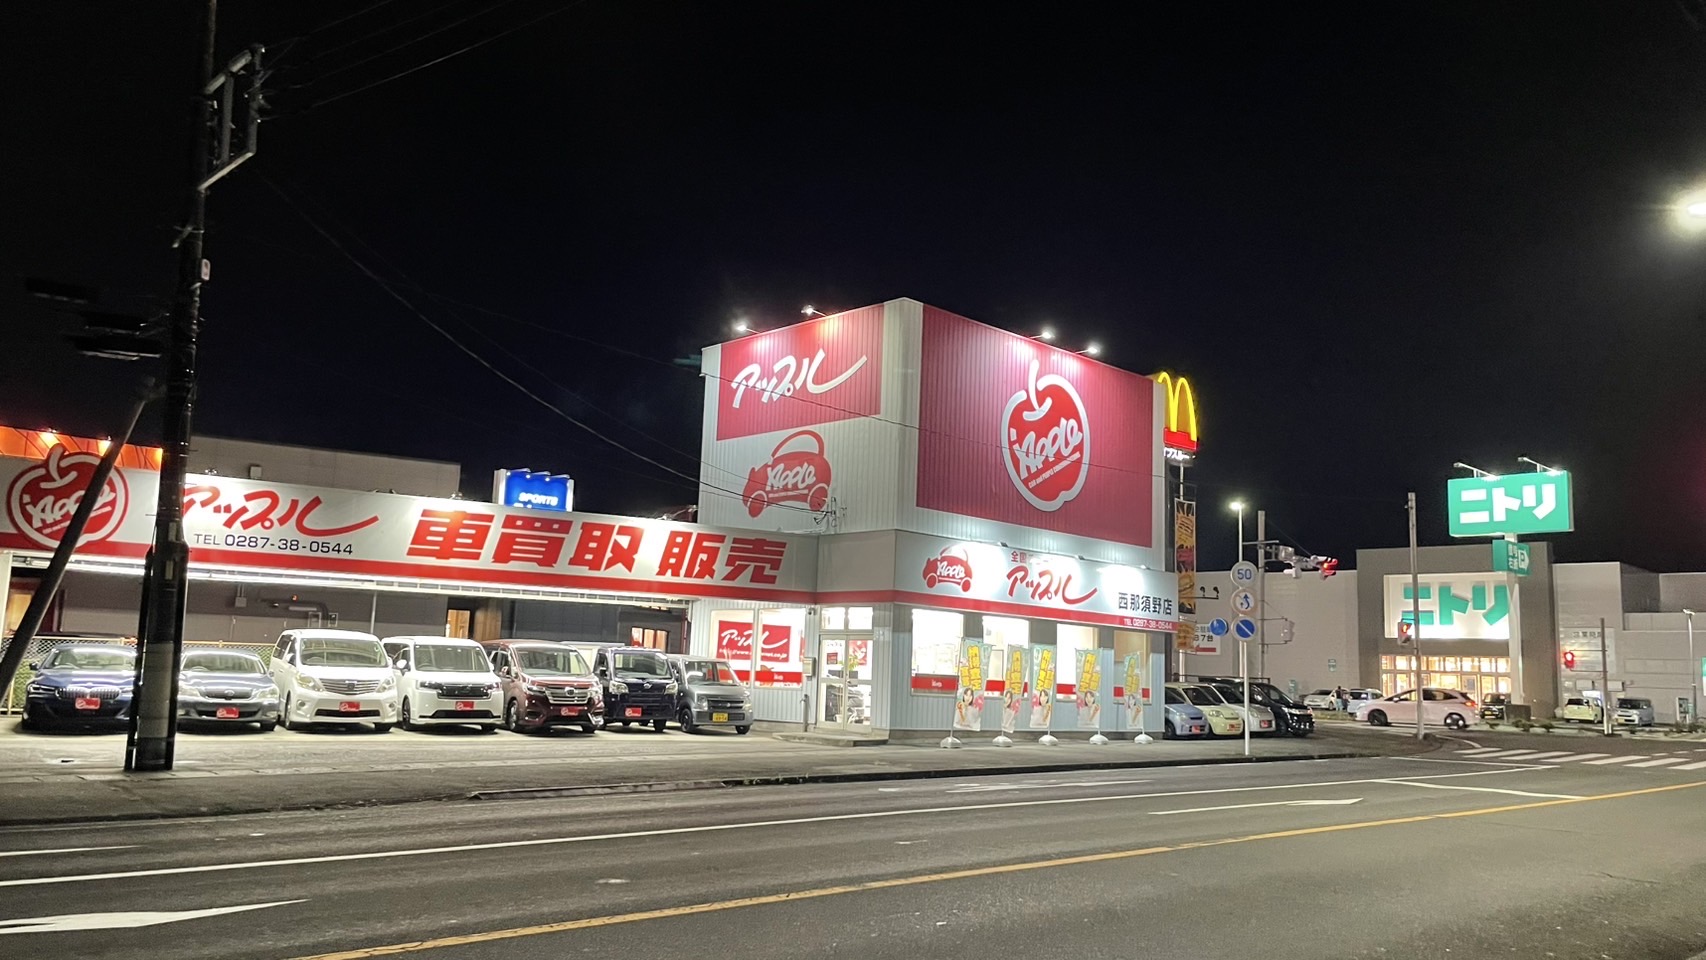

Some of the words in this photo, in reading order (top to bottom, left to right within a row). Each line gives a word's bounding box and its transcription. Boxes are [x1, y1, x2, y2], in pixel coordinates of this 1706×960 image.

[730, 347, 867, 409] アップル
[182, 484, 380, 538] アップル
[1459, 483, 1557, 524] ニトリ
[193, 533, 220, 546] TEL
[224, 534, 353, 555] 0287-38-0544
[406, 508, 645, 573] 車買取
[655, 530, 788, 585] 販売
[1006, 565, 1098, 605] アップル
[1237, 568, 1252, 580] 50
[1118, 591, 1173, 616] 西那須野店
[1401, 584, 1510, 626] ニトリ
